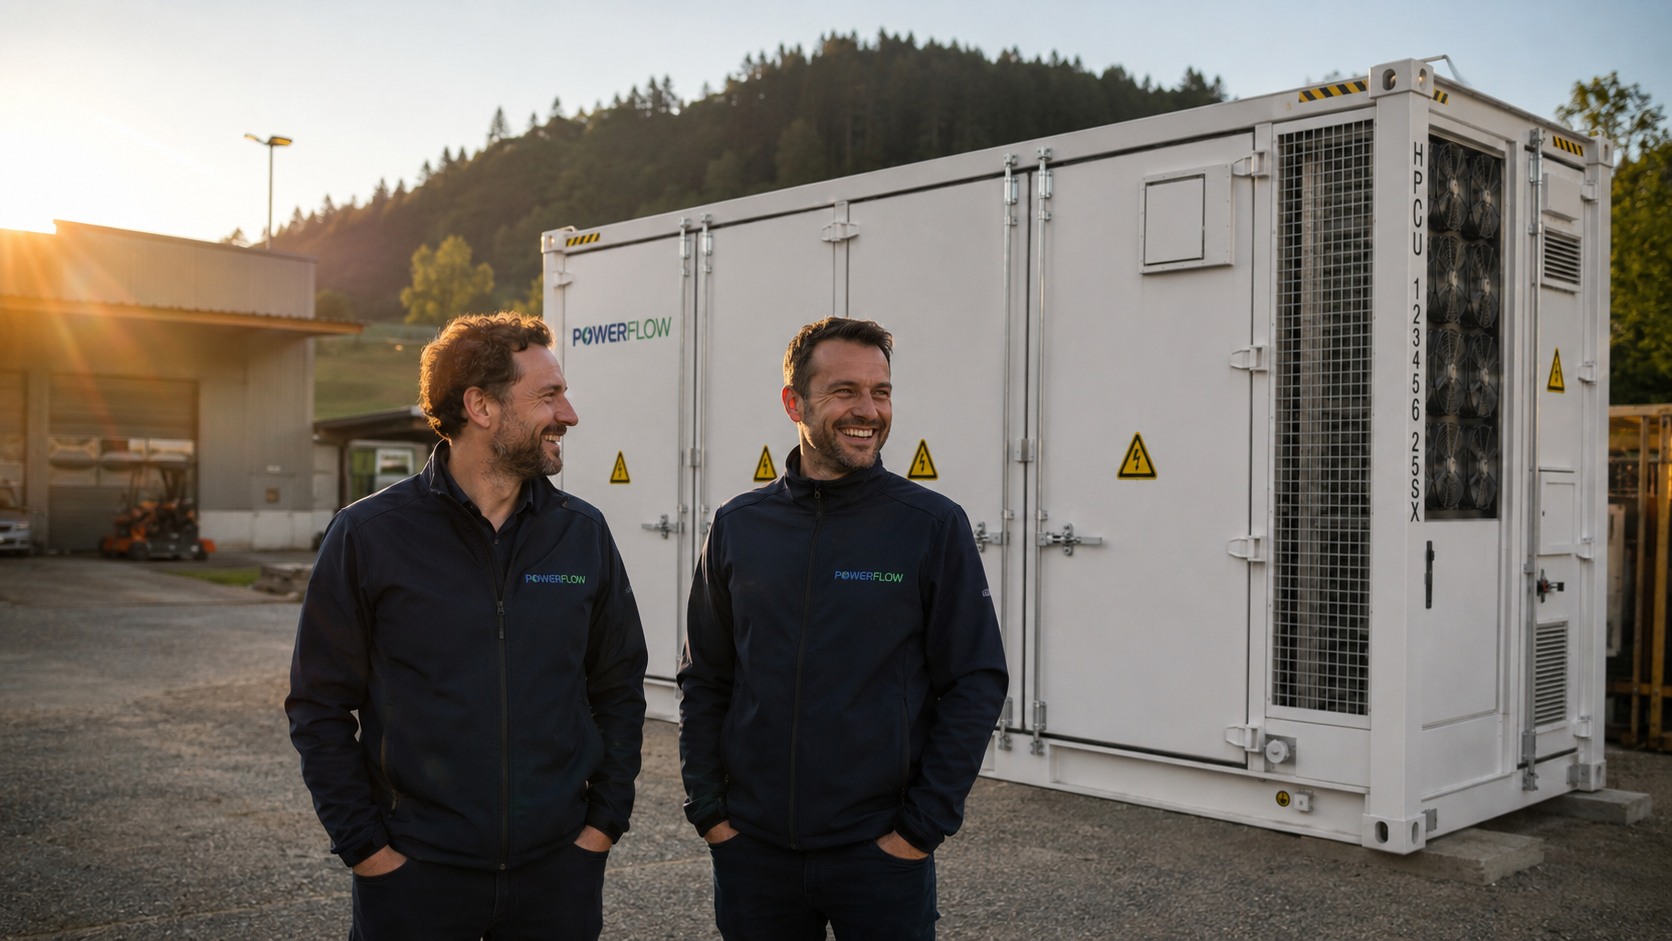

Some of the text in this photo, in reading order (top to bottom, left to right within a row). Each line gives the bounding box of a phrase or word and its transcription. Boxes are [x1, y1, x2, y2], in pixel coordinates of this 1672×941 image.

[572, 316, 672, 347] POWERFLOW
[1410, 141, 1423, 522] HPCU 123456 25SX
[525, 574, 586, 584] POWERFLOW
[834, 570, 904, 583] POWERFLOW
